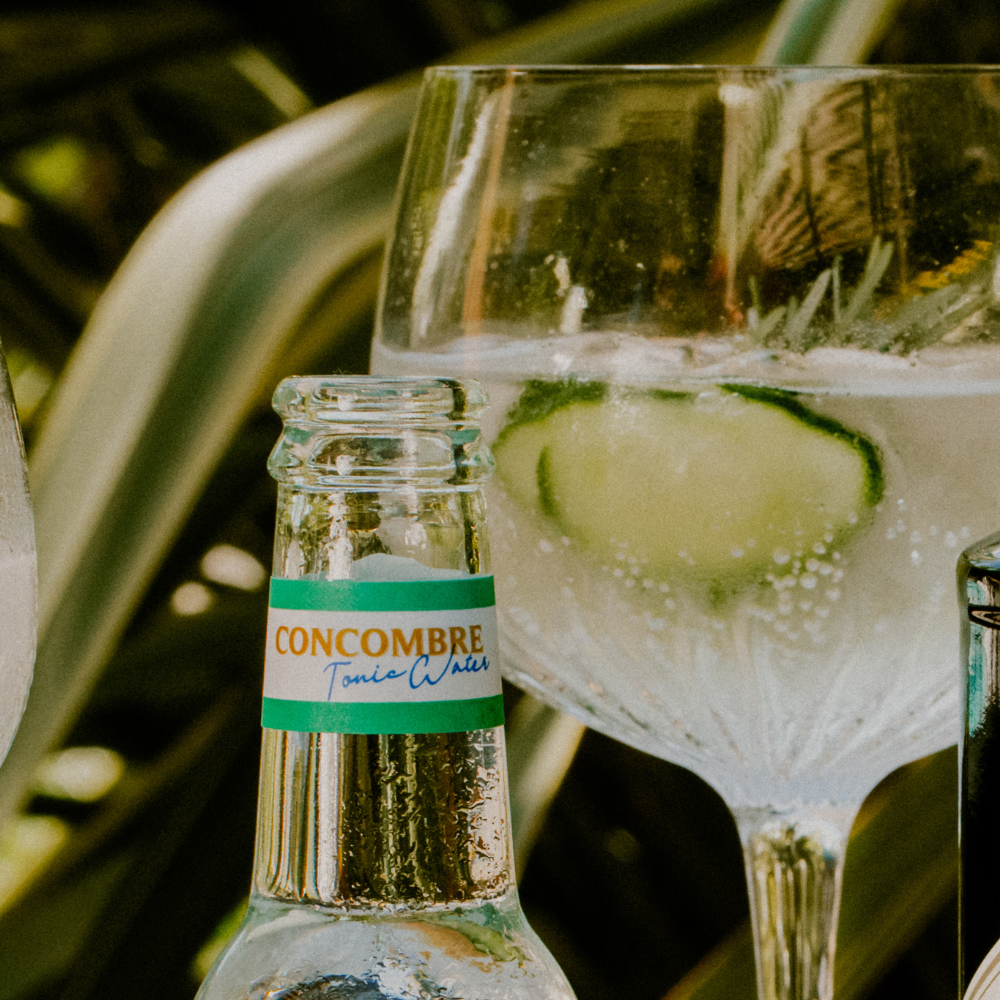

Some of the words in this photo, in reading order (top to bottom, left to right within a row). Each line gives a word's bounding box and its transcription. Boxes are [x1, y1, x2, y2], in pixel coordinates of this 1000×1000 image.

[275, 625, 484, 657] CONCOMBRE
[323, 661, 407, 701] Tonic
[409, 643, 490, 689] Water
